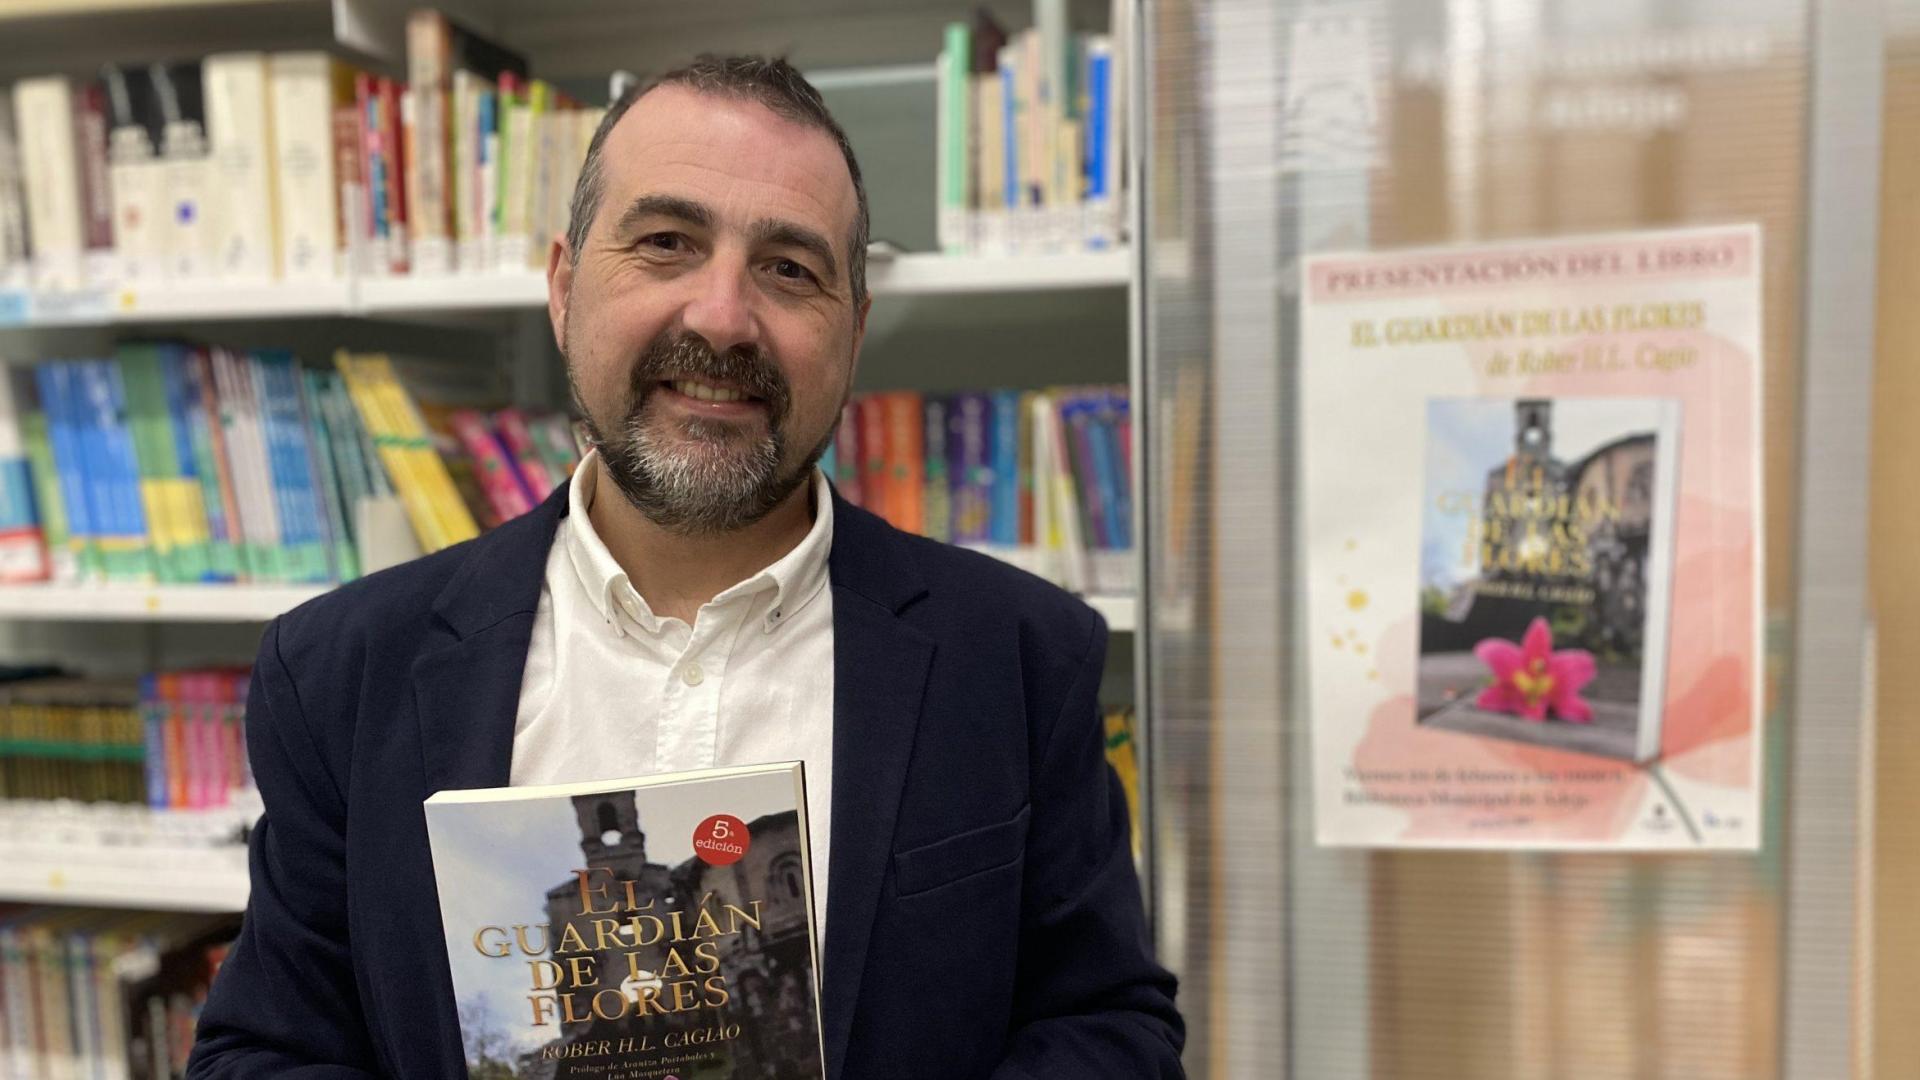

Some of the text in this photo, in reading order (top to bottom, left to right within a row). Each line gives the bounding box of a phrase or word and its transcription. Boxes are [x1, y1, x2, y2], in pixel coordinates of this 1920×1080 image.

[1567, 249, 1624, 276] DEL
[1637, 243, 1736, 273] LIBRO
[1350, 318, 1379, 348] EL
[1520, 310, 1551, 338] DE
[1559, 305, 1606, 333] LAS
[1485, 352, 1511, 378] de
[695, 838, 743, 855] edición
[571, 866, 655, 917] EL
[472, 891, 764, 958] GUARDIÁN
[527, 942, 721, 992] DE LAS
[526, 975, 731, 1027] FLORES
[541, 1023, 741, 1061] ROBER H.L. CAGIAO
